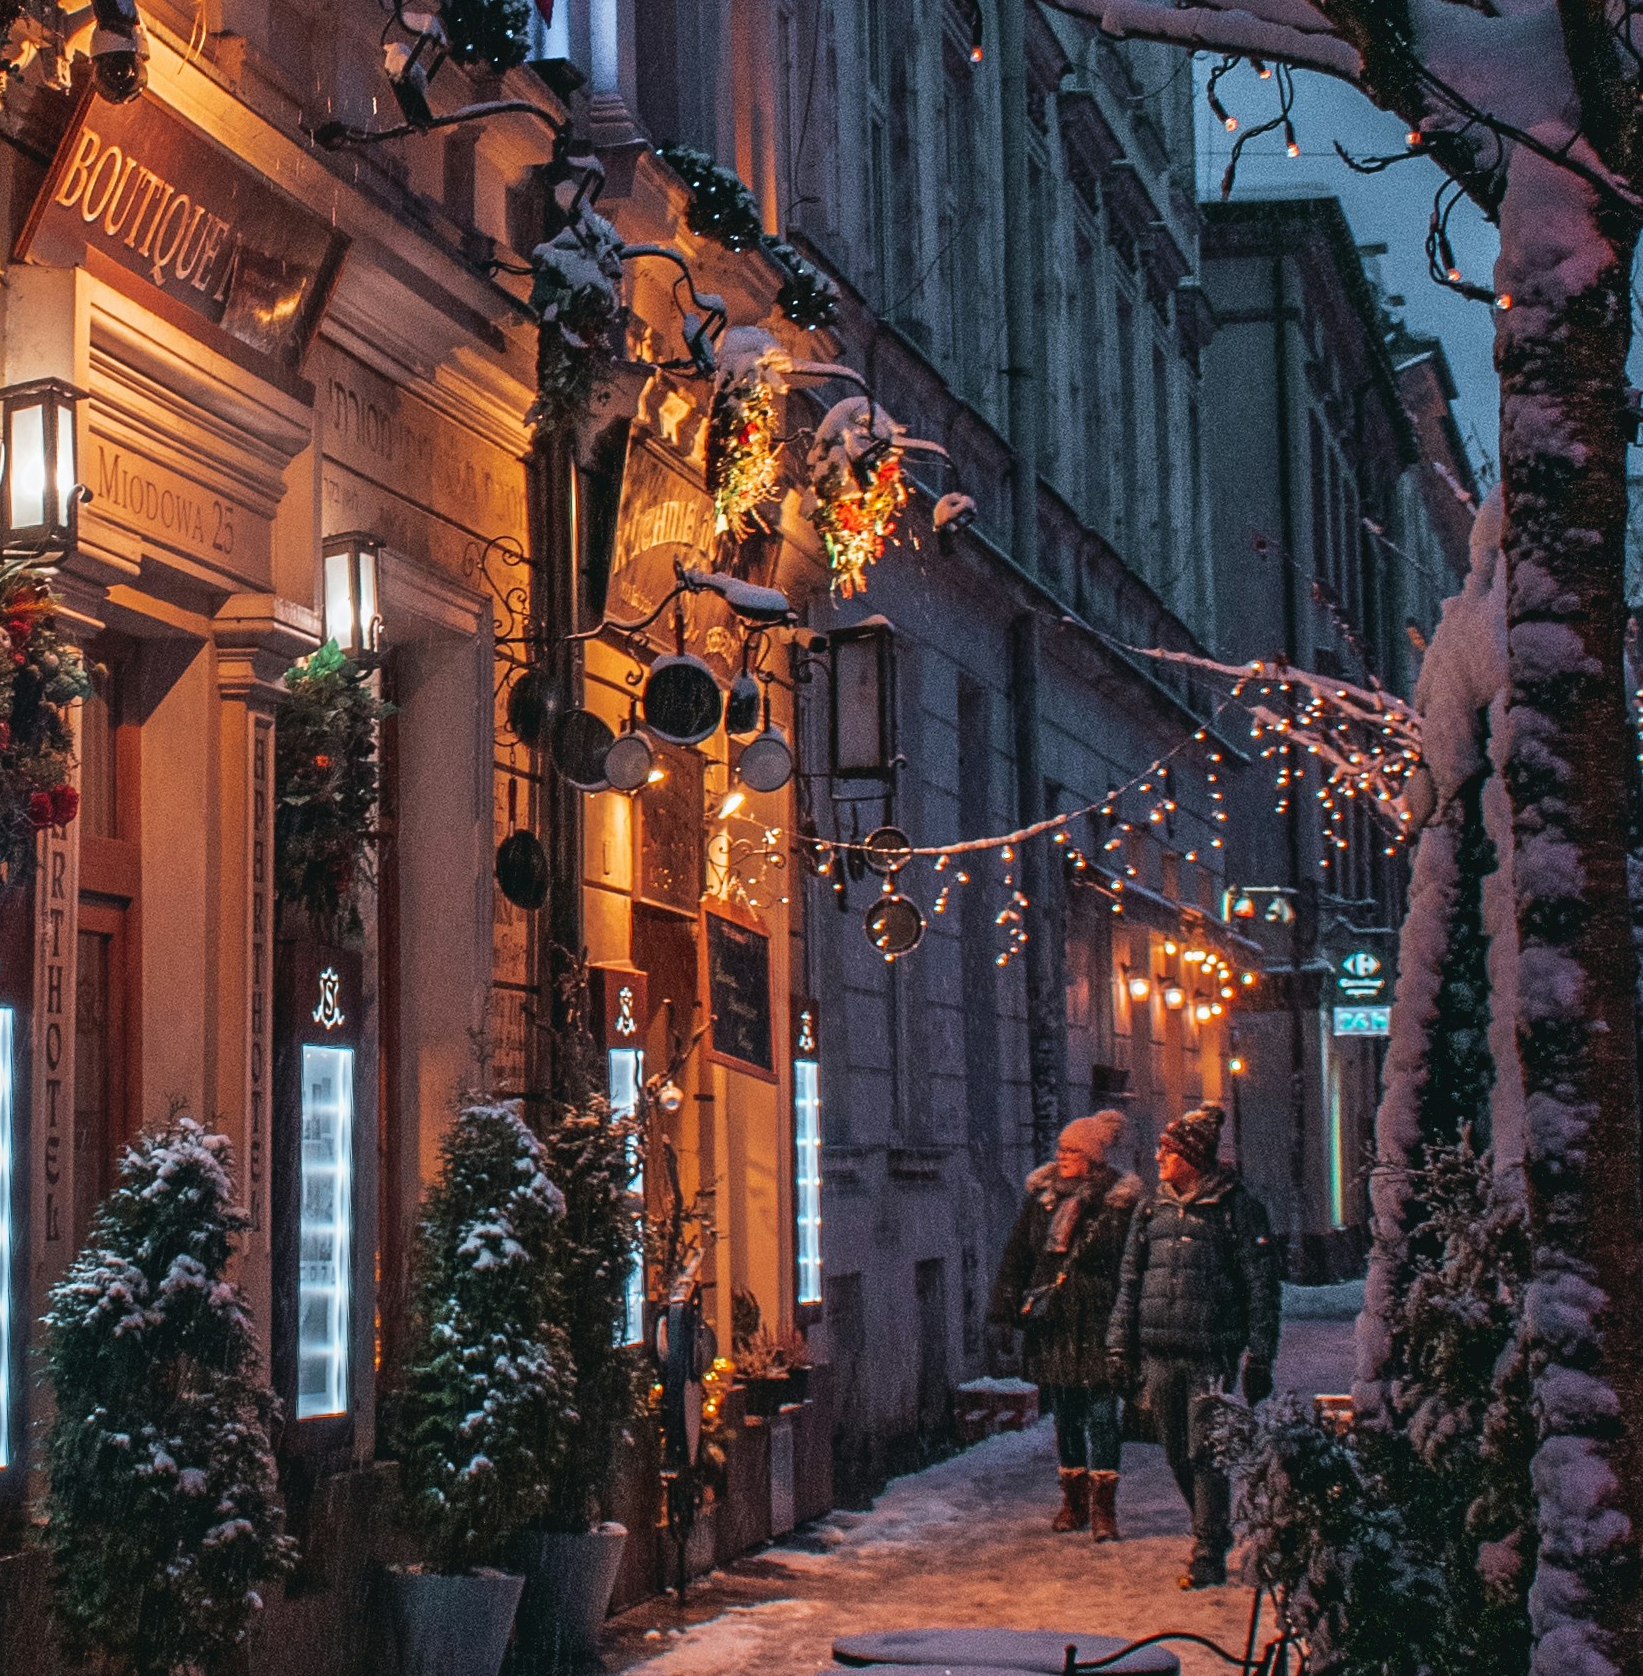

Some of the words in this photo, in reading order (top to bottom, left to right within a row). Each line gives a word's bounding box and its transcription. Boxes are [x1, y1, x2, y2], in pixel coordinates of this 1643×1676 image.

[54, 126, 230, 302] BOUTIQUE
[97, 444, 205, 543] MIODOWA
[211, 496, 235, 556] 25
